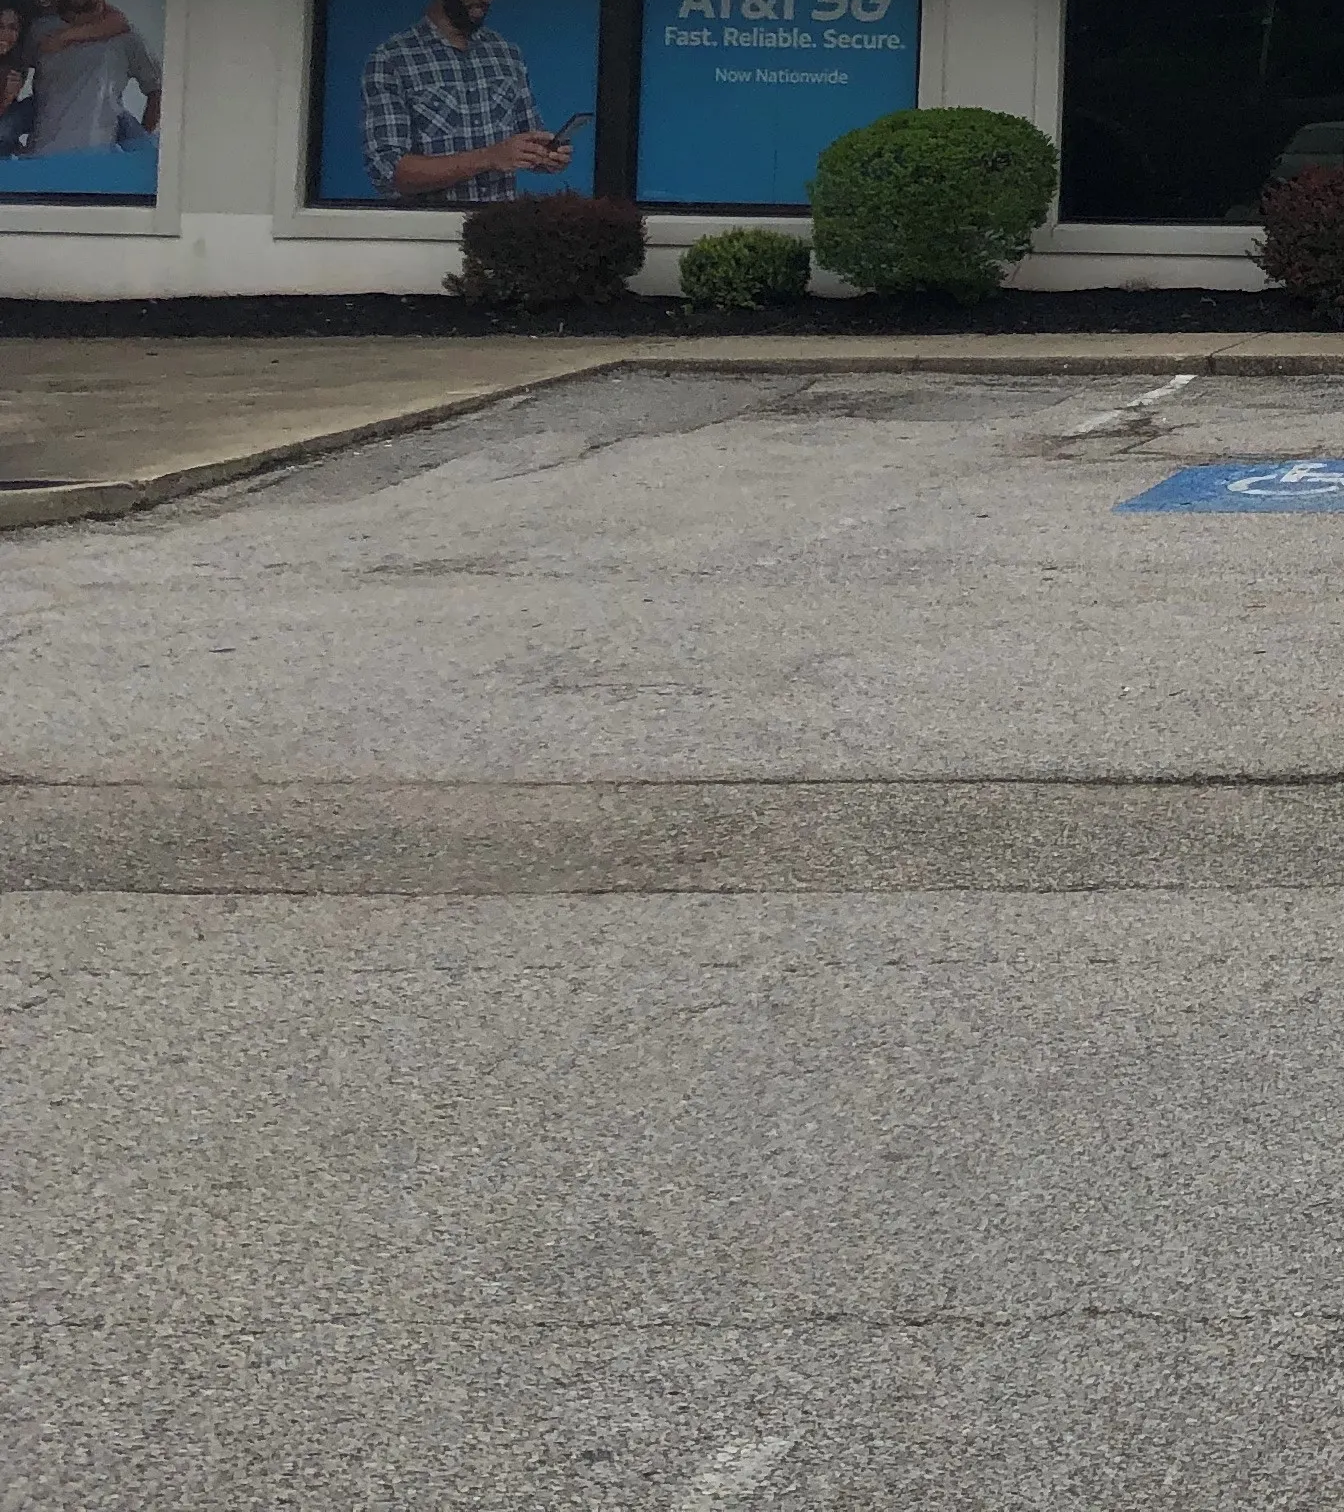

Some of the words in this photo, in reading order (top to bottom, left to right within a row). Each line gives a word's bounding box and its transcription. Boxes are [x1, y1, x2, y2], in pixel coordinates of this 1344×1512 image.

[664, 26, 718, 47] Fast.
[723, 27, 817, 49] Reliable.
[822, 29, 906, 50] Secure.
[715, 68, 751, 83] Now
[755, 68, 848, 85] Nationwide
